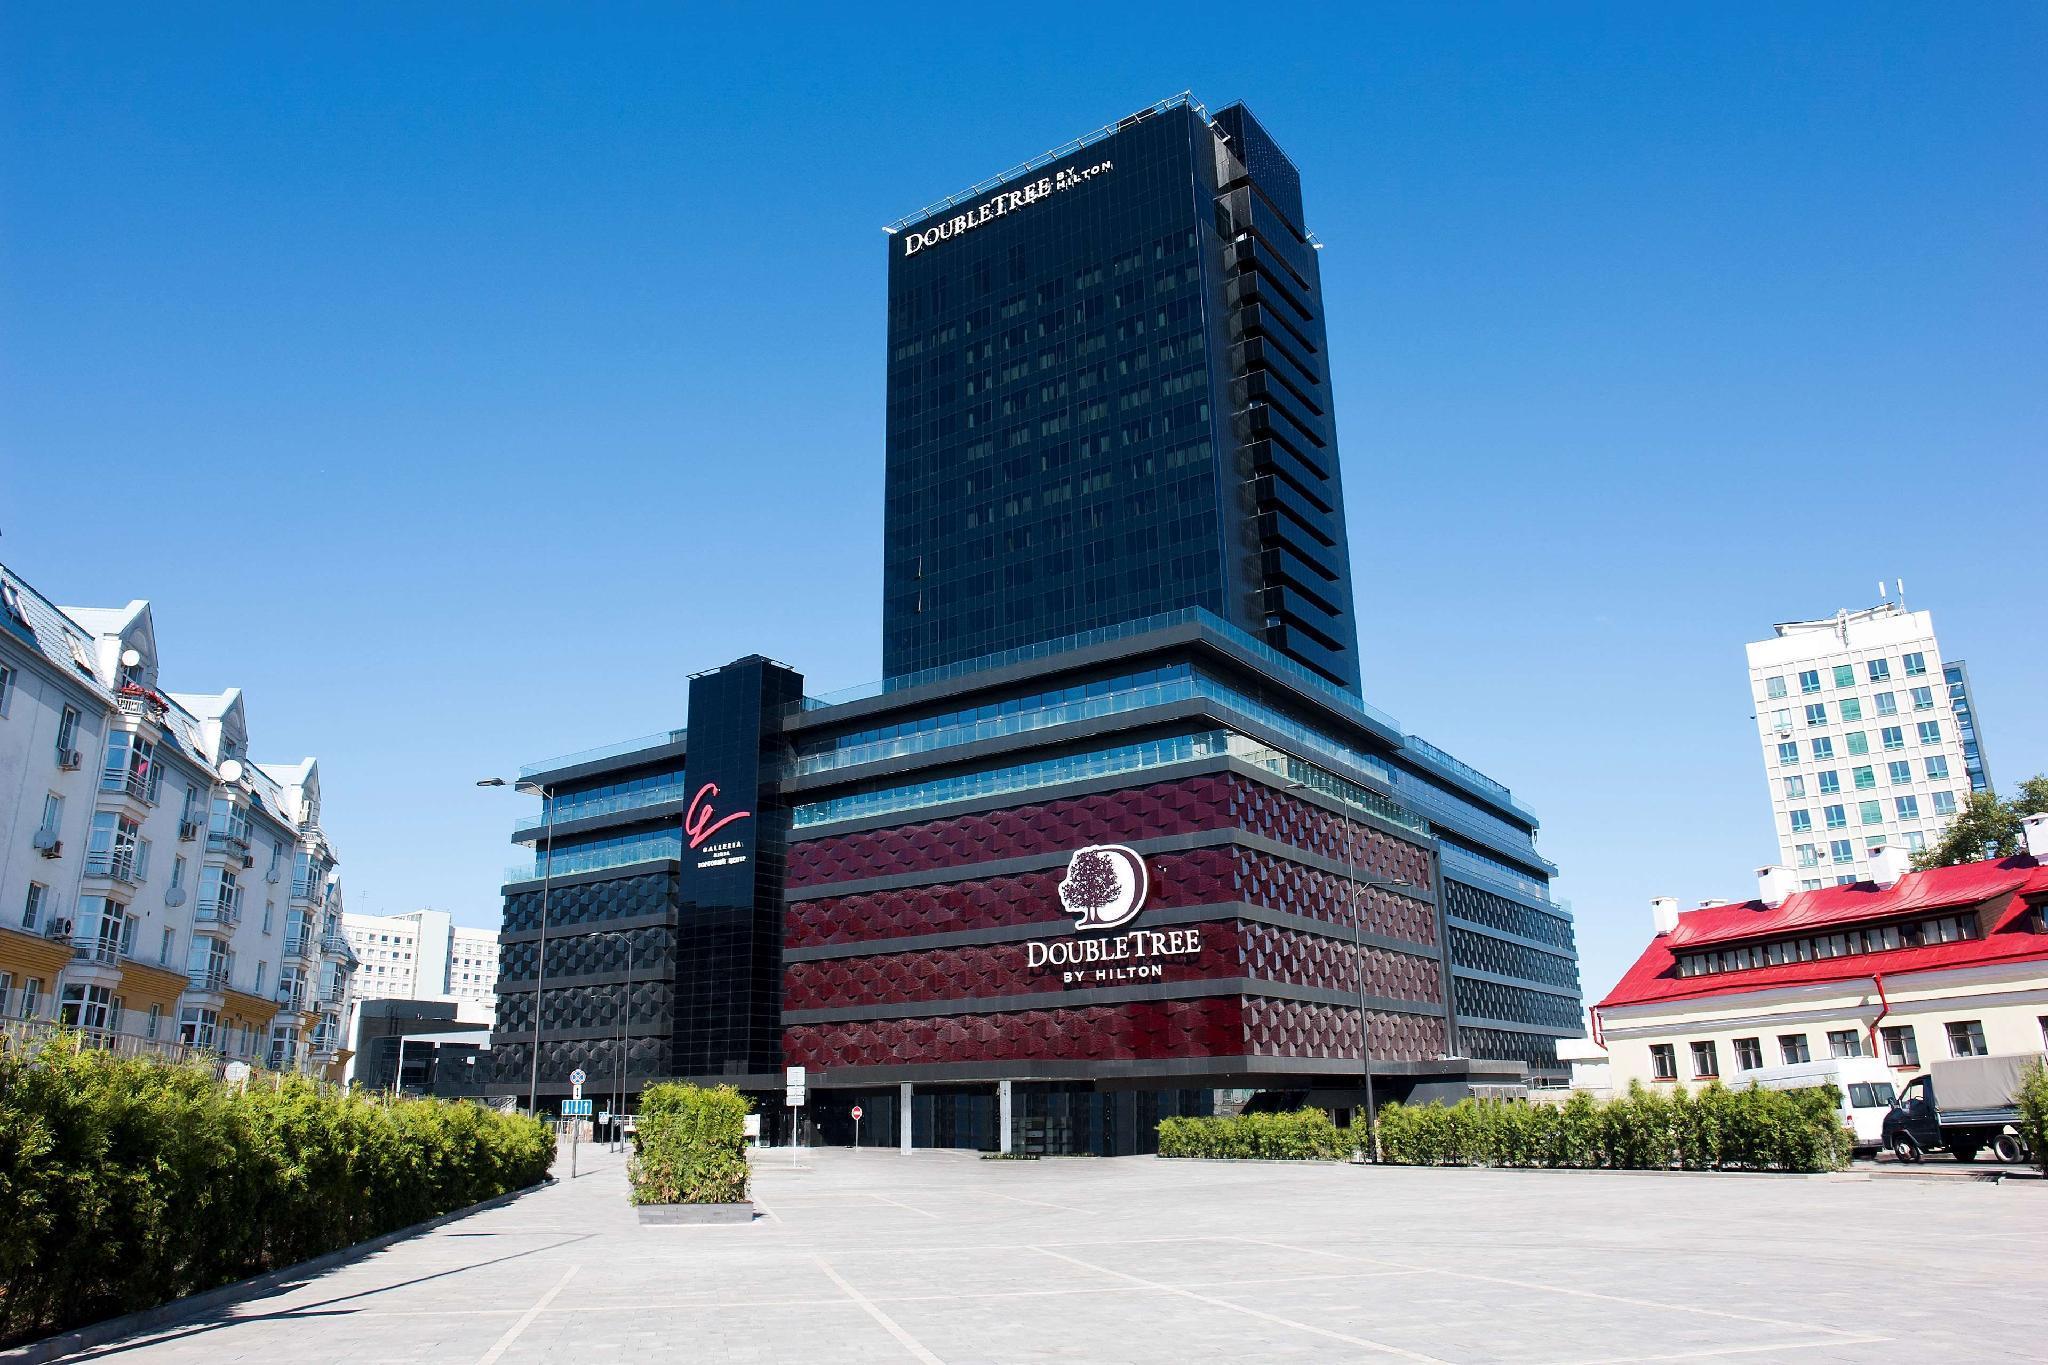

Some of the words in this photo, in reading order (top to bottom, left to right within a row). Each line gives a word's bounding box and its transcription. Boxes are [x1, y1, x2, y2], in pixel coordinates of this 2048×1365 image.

[1056, 166, 1075, 181] BY
[1056, 161, 1111, 190] HILTON
[1063, 970, 1085, 983] BY
[1095, 964, 1162, 981] HILTON
